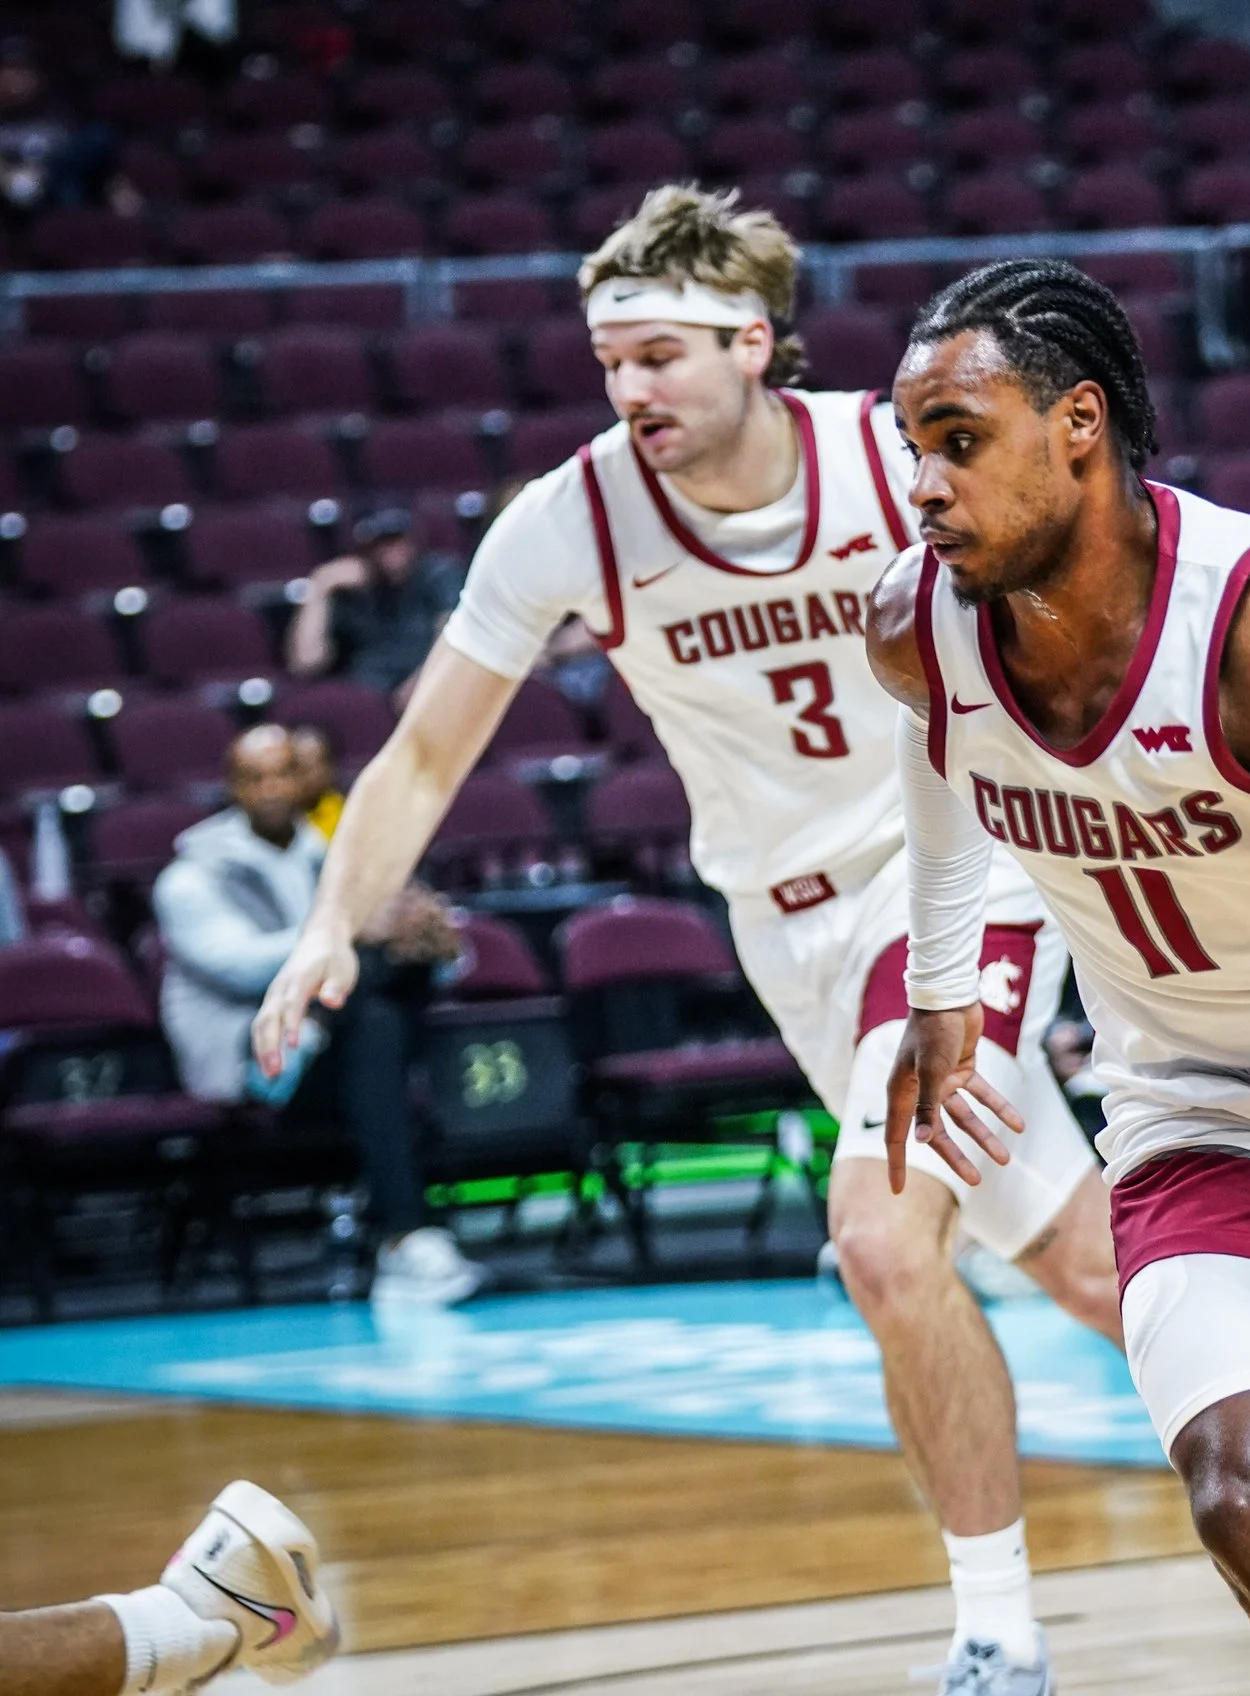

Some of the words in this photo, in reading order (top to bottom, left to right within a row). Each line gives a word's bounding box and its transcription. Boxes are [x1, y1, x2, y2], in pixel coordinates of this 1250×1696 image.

[661, 589, 869, 665] COUGAR
[761, 660, 850, 758] 3
[968, 770, 1242, 861] COUGARS
[1082, 864, 1222, 980] 11
